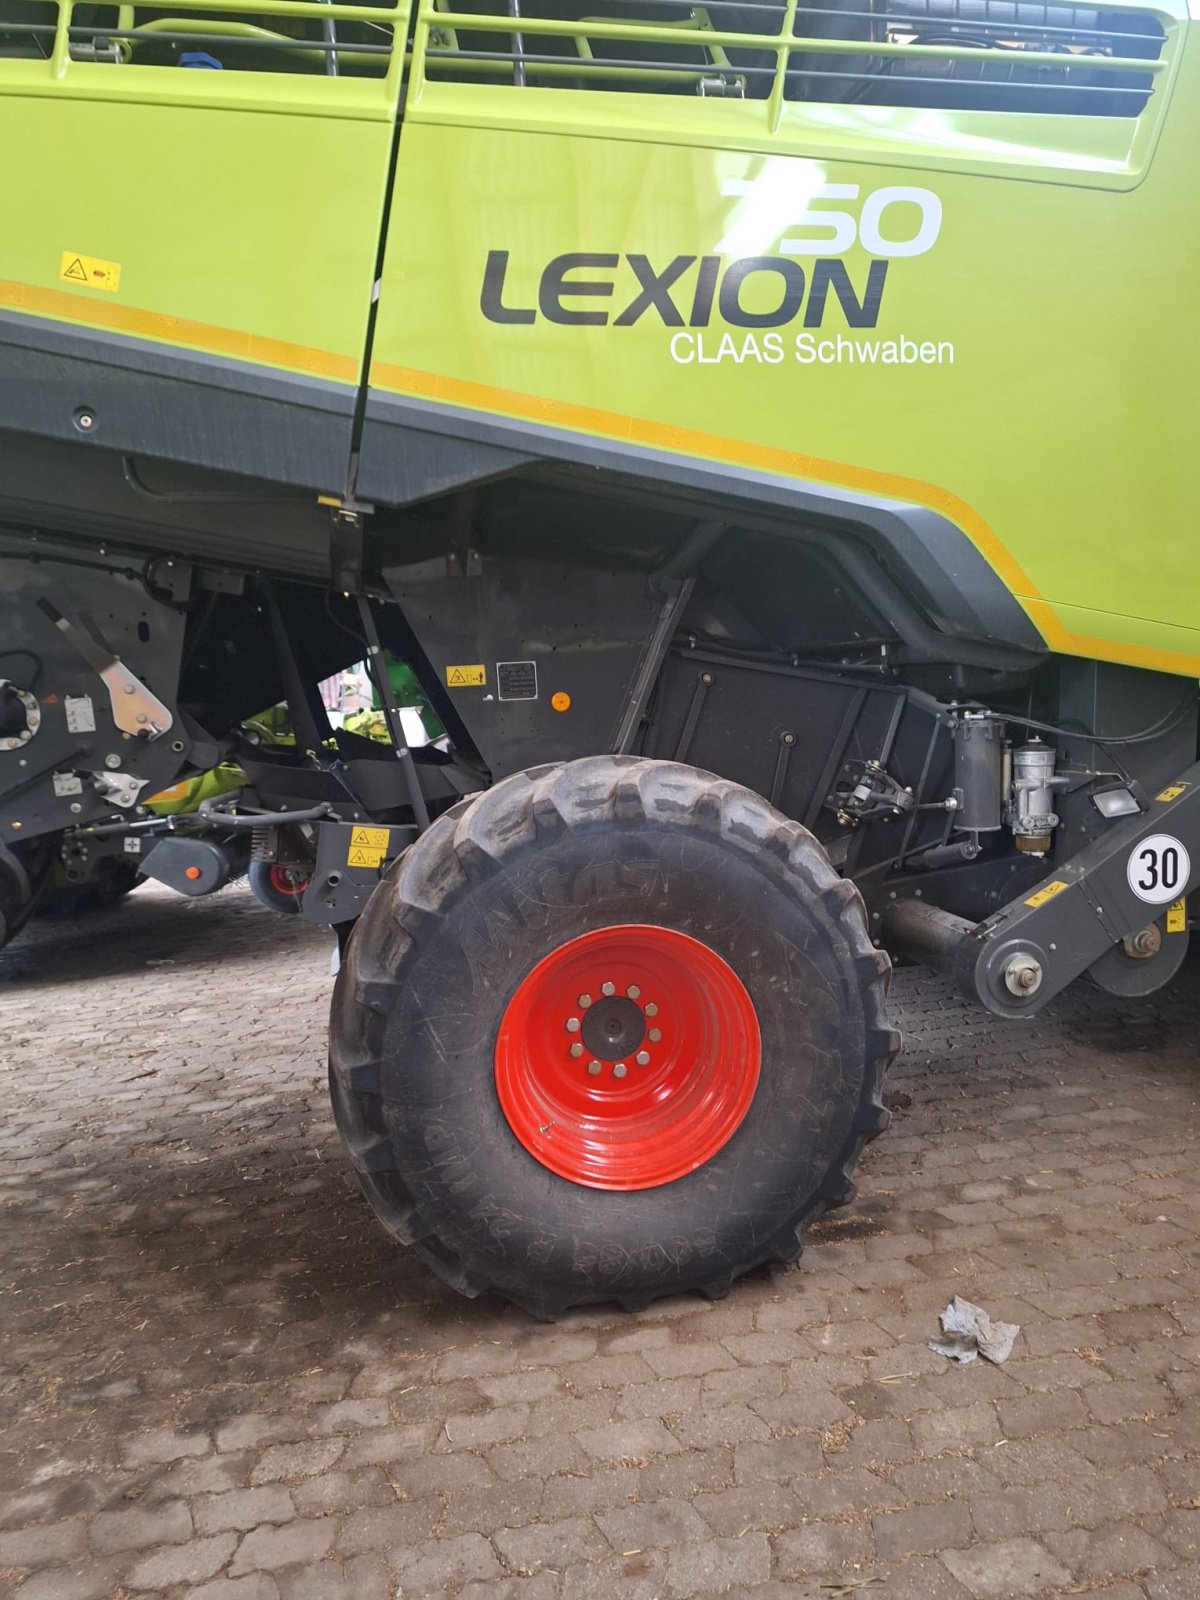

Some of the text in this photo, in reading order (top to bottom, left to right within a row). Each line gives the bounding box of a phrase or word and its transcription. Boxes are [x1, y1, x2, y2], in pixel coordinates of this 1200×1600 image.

[713, 180, 943, 257] 750
[480, 250, 889, 328] LEXION
[670, 332, 954, 364] CLAAS Schwaben
[1138, 847, 1178, 891] 30
